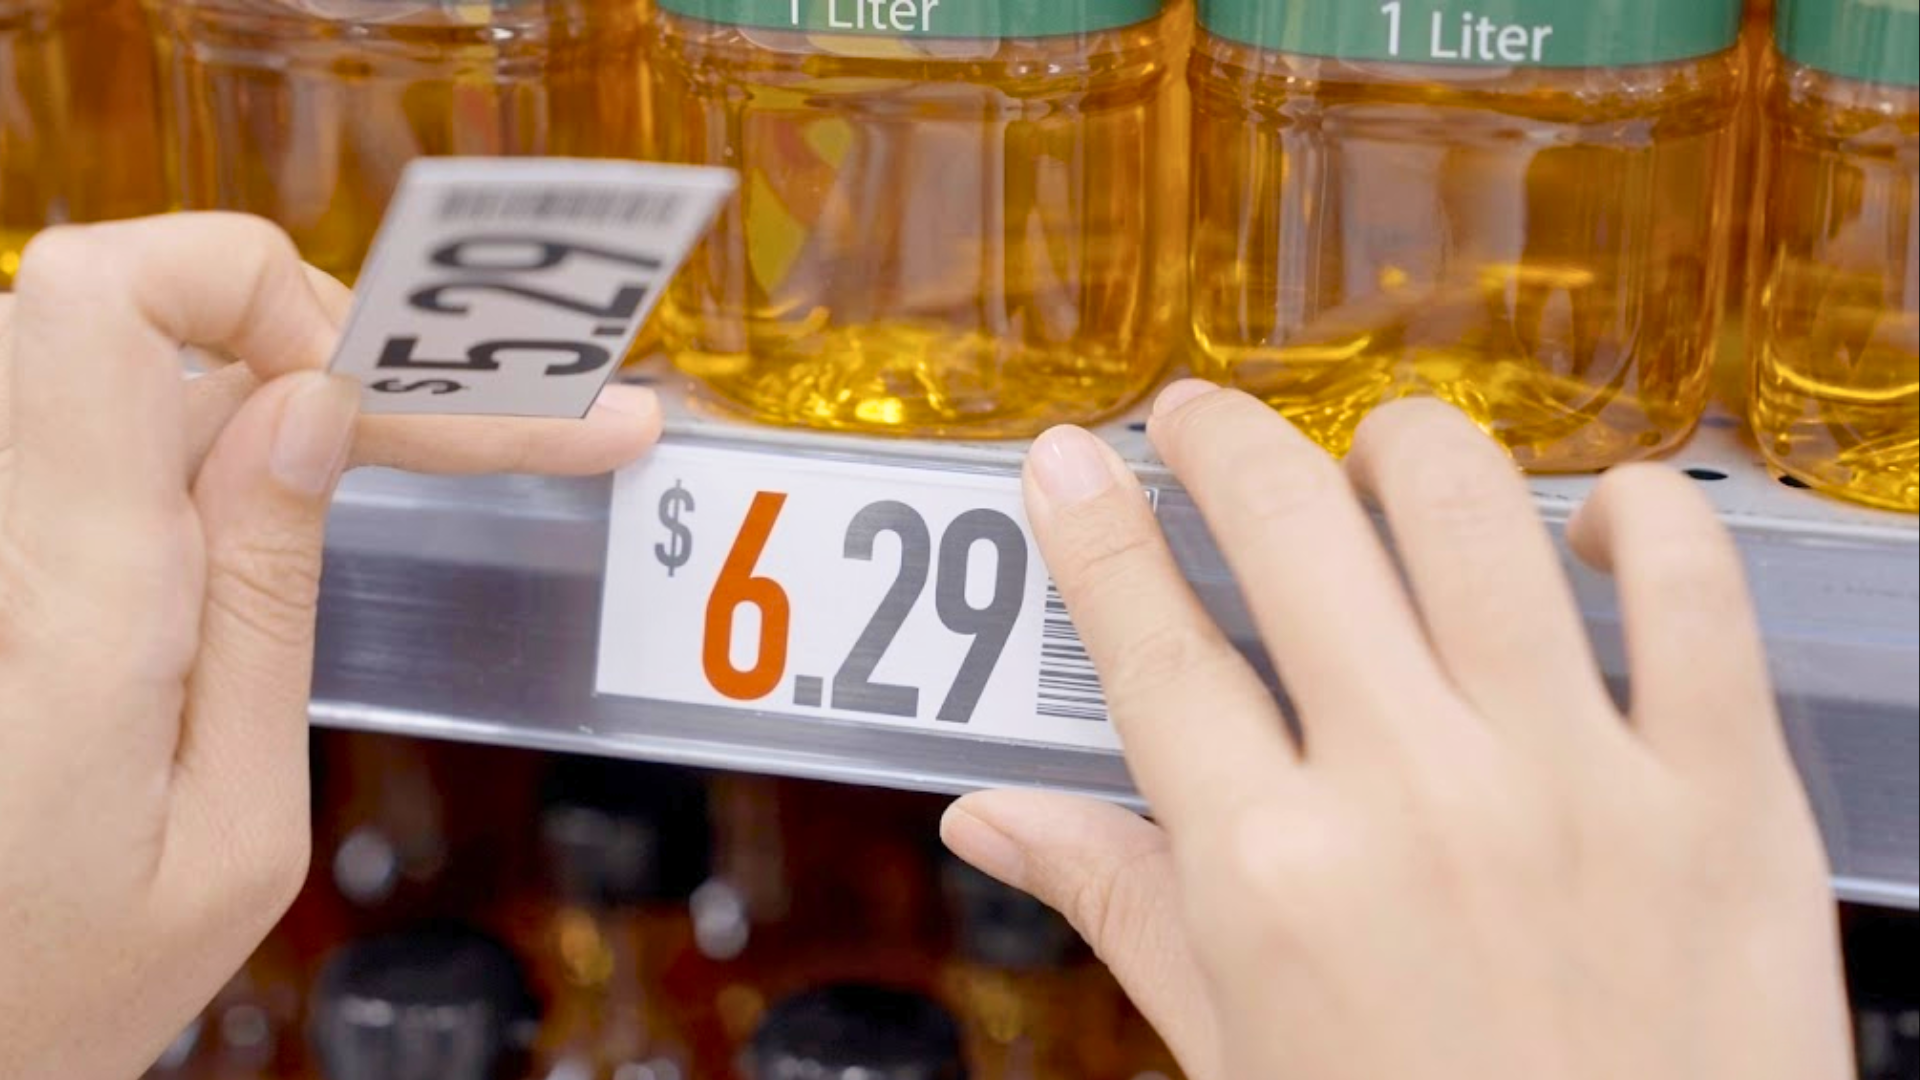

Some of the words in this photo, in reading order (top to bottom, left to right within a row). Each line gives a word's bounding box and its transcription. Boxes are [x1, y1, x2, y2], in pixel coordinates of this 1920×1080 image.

[828, 0, 939, 31] Liter
[1380, 0, 1401, 56] 1
[1430, 11, 1554, 62] Liter
